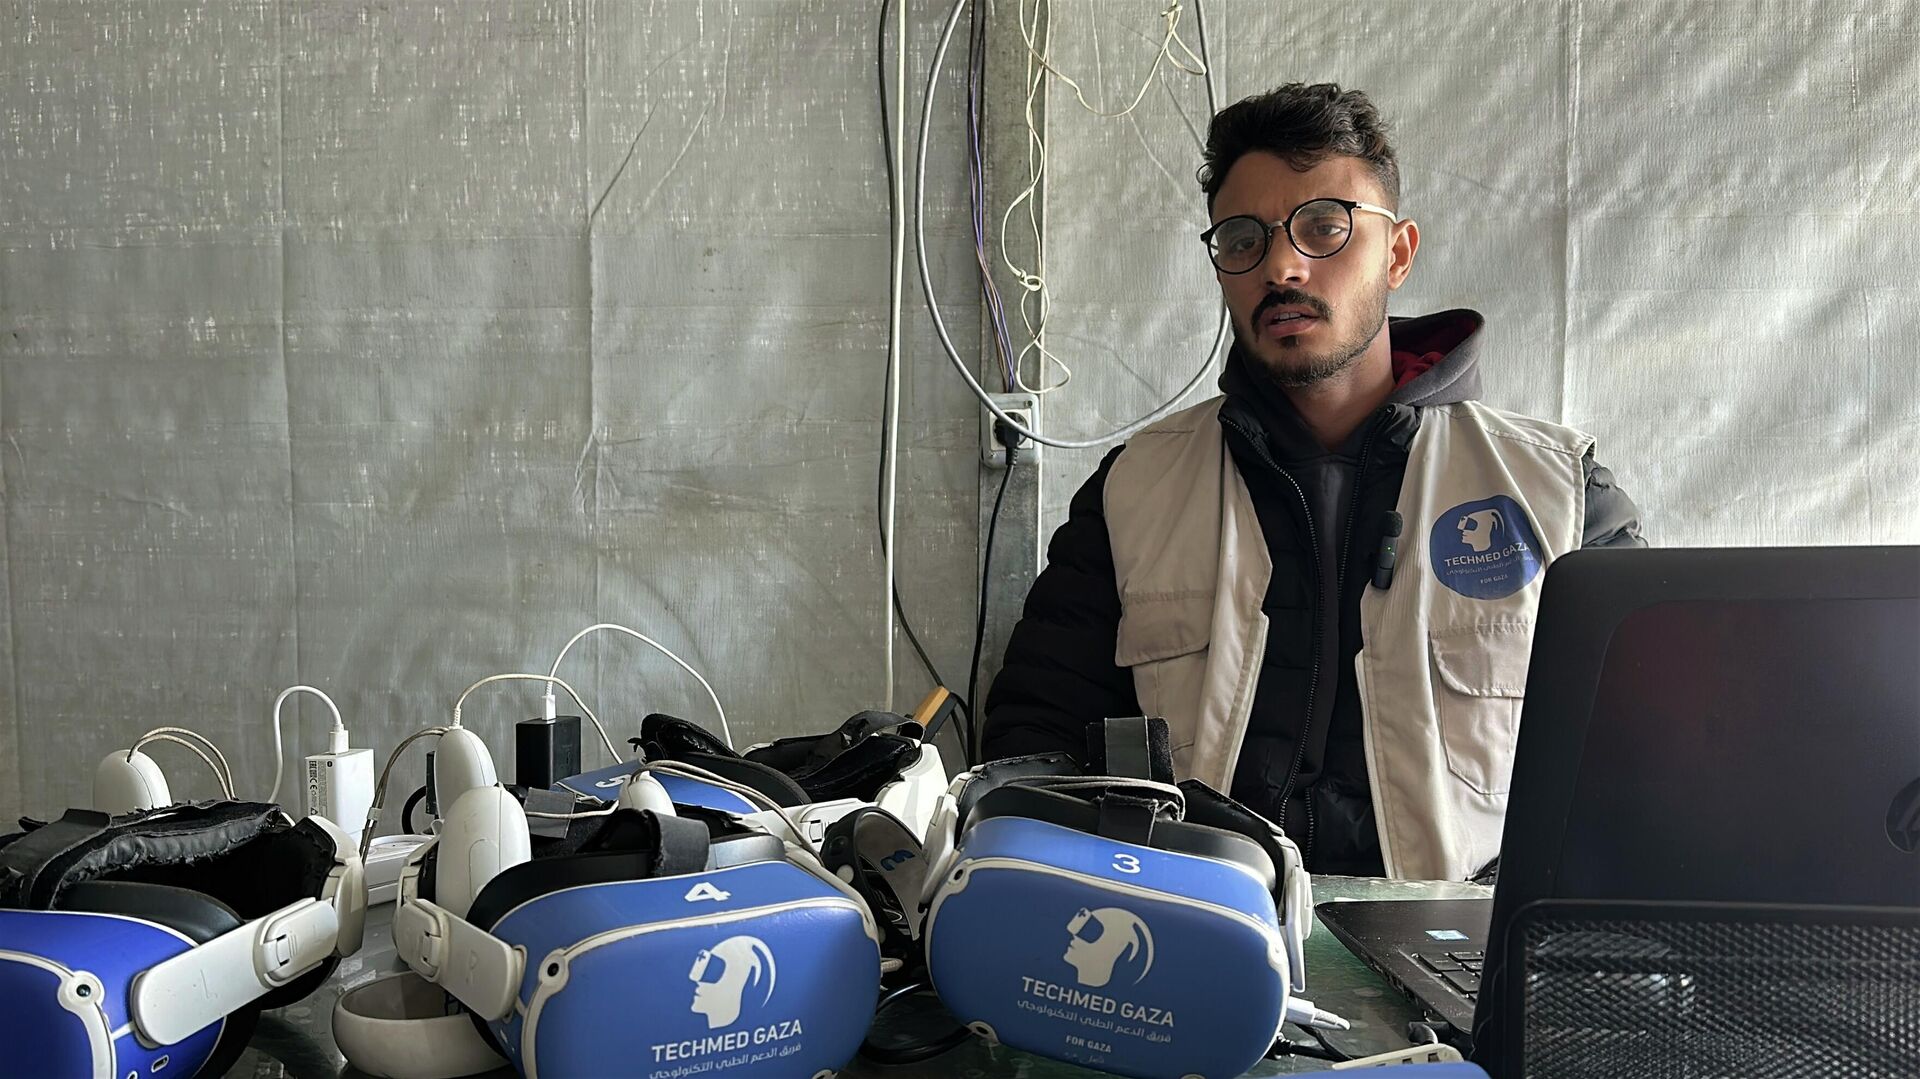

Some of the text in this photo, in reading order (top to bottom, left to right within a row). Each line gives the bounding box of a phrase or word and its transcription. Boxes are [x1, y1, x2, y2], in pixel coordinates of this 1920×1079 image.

[1444, 551, 1501, 567] TECHMED
[1502, 542, 1531, 557] GAZA
[1112, 853, 1141, 874] 3
[684, 882, 731, 902] 4
[1022, 976, 1174, 1028] TECHMED GAZA
[1079, 1015, 1114, 1031] الطبي
[1114, 1024, 1145, 1038] الدعم
[652, 1019, 803, 1063] TECHMED GAZA
[1066, 1035, 1112, 1053] FOR GAZA
[1146, 1030, 1171, 1043] فريق
[750, 1047, 778, 1064] الدعم
[779, 1042, 802, 1057] فريق
[716, 1054, 750, 1071] الطبي
